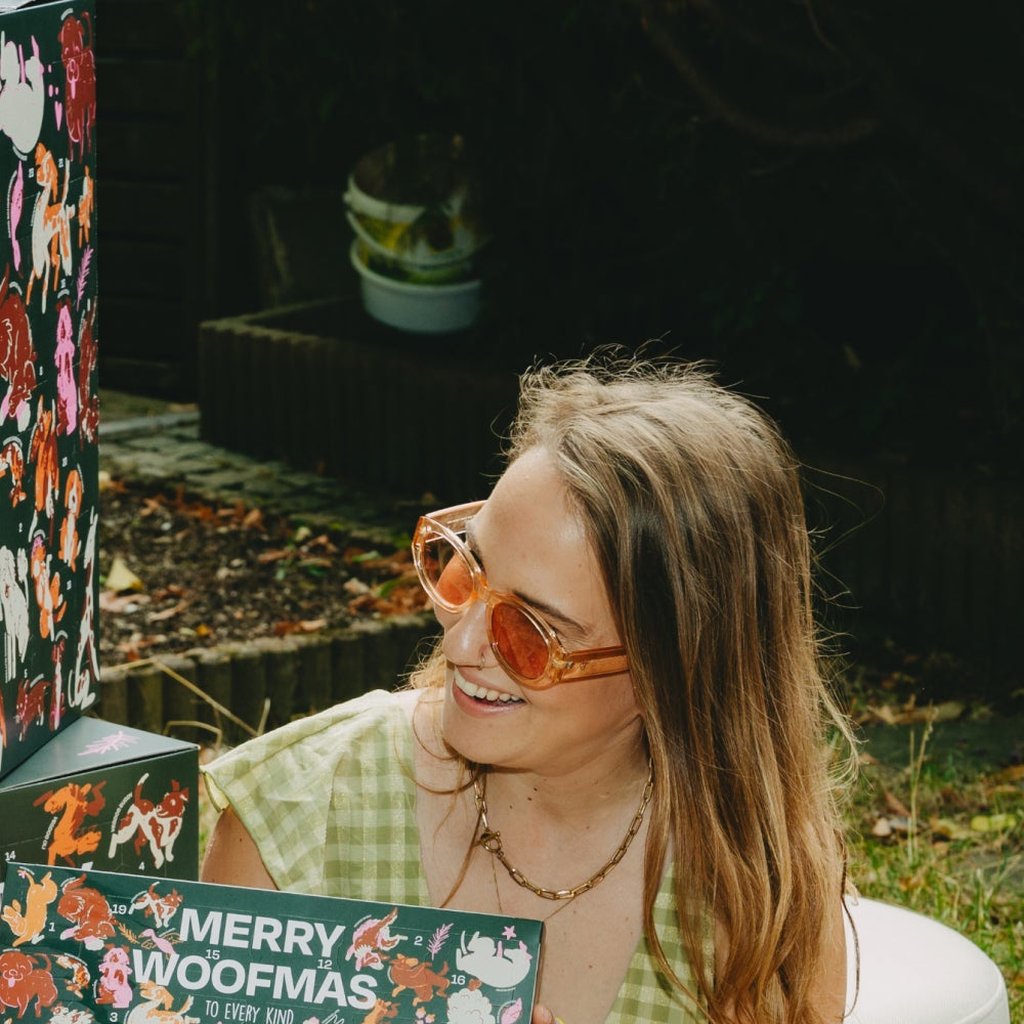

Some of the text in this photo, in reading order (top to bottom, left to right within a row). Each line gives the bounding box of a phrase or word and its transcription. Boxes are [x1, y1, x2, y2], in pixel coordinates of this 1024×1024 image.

[5, 851, 16, 861] 14
[138, 861, 145, 870] 4
[112, 904, 127, 915] 19
[49, 922, 55, 932] 1
[180, 908, 346, 958] MERRY
[413, 936, 423, 946] 2
[205, 950, 220, 960] 15
[318, 959, 332, 970] 12
[133, 949, 378, 1010] WOOFMAS
[451, 975, 465, 985] 16
[206, 1000, 219, 1015] TO
[225, 1002, 261, 1023] EVERY
[110, 1012, 118, 1022] 3
